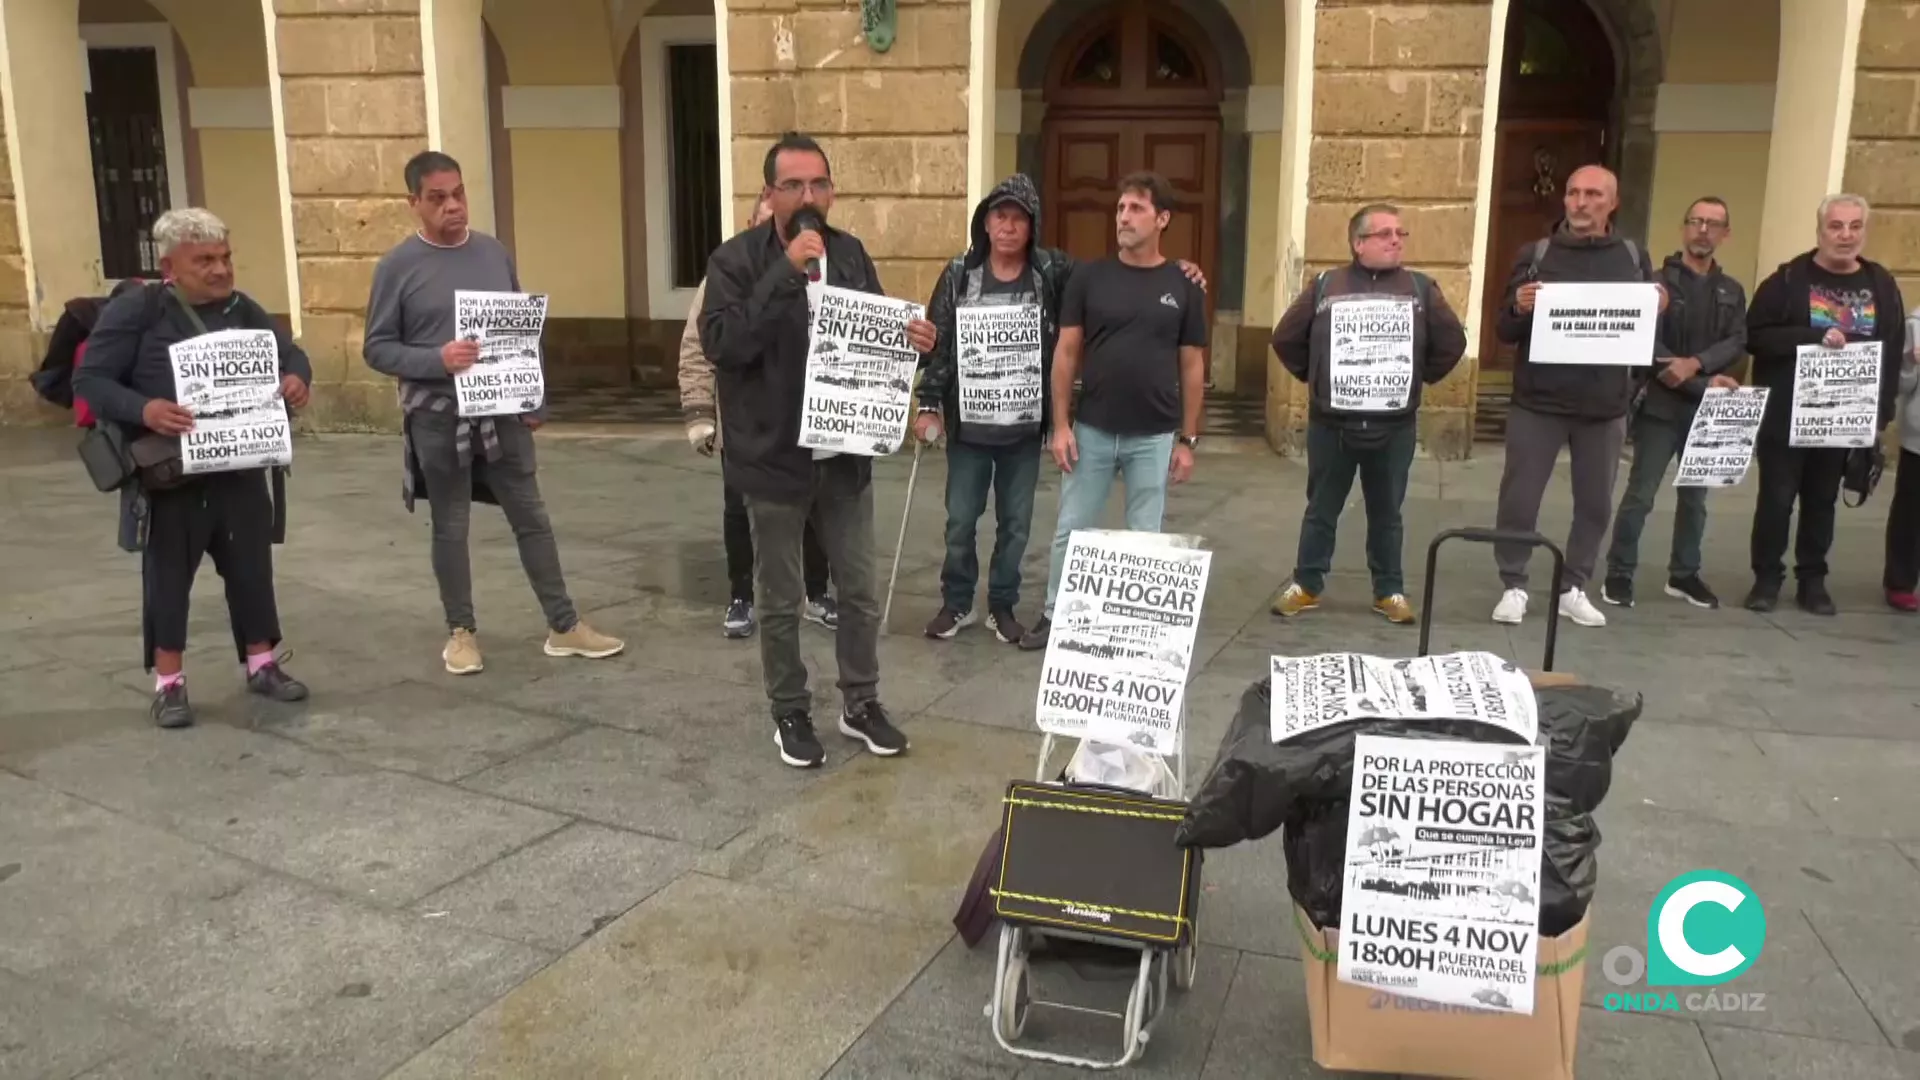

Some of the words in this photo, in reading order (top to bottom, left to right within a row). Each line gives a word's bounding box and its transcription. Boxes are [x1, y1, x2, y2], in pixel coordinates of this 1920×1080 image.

[460, 297, 477, 306] POR
[822, 294, 844, 307] POR
[846, 299, 858, 309] LA
[460, 308, 471, 316] DE
[821, 307, 836, 318] DE
[839, 311, 859, 322] LAS
[862, 314, 907, 330] PERSON
[1365, 313, 1410, 321] PERSONAS
[1549, 308, 1597, 318] ABANDONAR
[1599, 308, 1641, 318] PERSONAS
[460, 317, 484, 330] SIN
[486, 317, 542, 329] HOGAR
[817, 319, 847, 338] SIN
[961, 322, 971, 331] DE
[973, 322, 990, 330] LAS
[992, 320, 1038, 330] PERSONAS
[1335, 322, 1356, 334] SIN
[1360, 321, 1410, 334] HOGAR
[1552, 321, 1561, 331] EN
[1563, 321, 1572, 331] LA
[1574, 321, 1596, 331] CALLE
[1609, 321, 1635, 331] ILEGAL
[960, 331, 984, 344] SIN
[987, 329, 1039, 344] HOGAR
[200, 341, 212, 350] LA
[178, 353, 191, 362] DE
[195, 351, 217, 361] LAS
[219, 349, 273, 360] PERSONAS
[180, 363, 209, 378] SIN
[214, 361, 273, 376] HOGAR
[1800, 367, 1822, 378] SIN
[1825, 366, 1876, 378] HOGAR
[460, 373, 501, 388] LUNES
[504, 375, 511, 384] 4
[514, 373, 539, 384] NOV
[1334, 375, 1371, 386] LUNES
[1374, 376, 1380, 385] 4
[1383, 375, 1410, 386] NOV
[462, 387, 502, 402] 18:00H
[963, 387, 1001, 400] LUNES
[1003, 389, 1010, 399] 4
[1013, 387, 1040, 399] NOV
[1335, 387, 1370, 398] 18:00H
[809, 397, 857, 416] LUNES
[860, 405, 868, 418] 4
[872, 405, 905, 422] NOV
[963, 401, 1000, 412] 18:00H
[1697, 407, 1715, 418] SIN
[1716, 407, 1761, 418] HOGAR
[807, 415, 855, 434] 18:00H
[856, 421, 887, 433] PUERTA
[888, 424, 901, 434] DEL
[1796, 416, 1833, 426] LUNES
[1836, 417, 1843, 425] 4
[1846, 415, 1872, 425] NOV
[188, 429, 237, 446] LUNES
[240, 430, 248, 440] 4
[252, 425, 284, 440] NOV
[1796, 427, 1832, 437] 18:00H
[188, 445, 238, 460] 18:00H
[240, 442, 270, 450] PUERTA
[1684, 456, 1715, 466] LUNES
[1718, 457, 1724, 465] 4
[1725, 456, 1748, 466] NOV
[1072, 545, 1099, 559] POR
[1101, 549, 1116, 562] LA
[1070, 559, 1089, 572] DE
[1091, 561, 1117, 577] LAS
[1120, 566, 1199, 591] PERSONAS
[1065, 573, 1103, 596] SIN
[1106, 579, 1196, 612] HOGAR
[1320, 655, 1346, 697] HOGAR
[1047, 667, 1109, 693] LUNES
[1112, 679, 1124, 696] 4
[1128, 681, 1176, 706] NOV
[1043, 689, 1103, 716] 18:00H
[1447, 683, 1478, 716] LUNES
[1105, 699, 1148, 717] PUERTA
[1150, 708, 1171, 721] DEL
[1322, 697, 1348, 720] SIN
[1104, 711, 1171, 730] AYUNTAMIENTO
[1363, 755, 1399, 771] POR
[1403, 758, 1424, 774] LA
[1362, 774, 1388, 790] DE
[1392, 777, 1428, 794] LAS
[1433, 779, 1535, 800] PERSONAS
[1359, 792, 1411, 820] SIN
[1418, 797, 1535, 830] HOGAR
[1418, 829, 1439, 841] Que
[1442, 833, 1454, 841] se
[1456, 832, 1493, 846] cumpla
[1496, 834, 1505, 845] la
[1352, 913, 1438, 944] LUNES
[1444, 925, 1460, 947] 4
[1466, 927, 1528, 954] NOV
[1349, 941, 1435, 971] 18:00H
[1438, 951, 1495, 970] PUERTA
[1500, 958, 1527, 974] DEL
[1437, 964, 1526, 984] AYUNTAMIENTO
